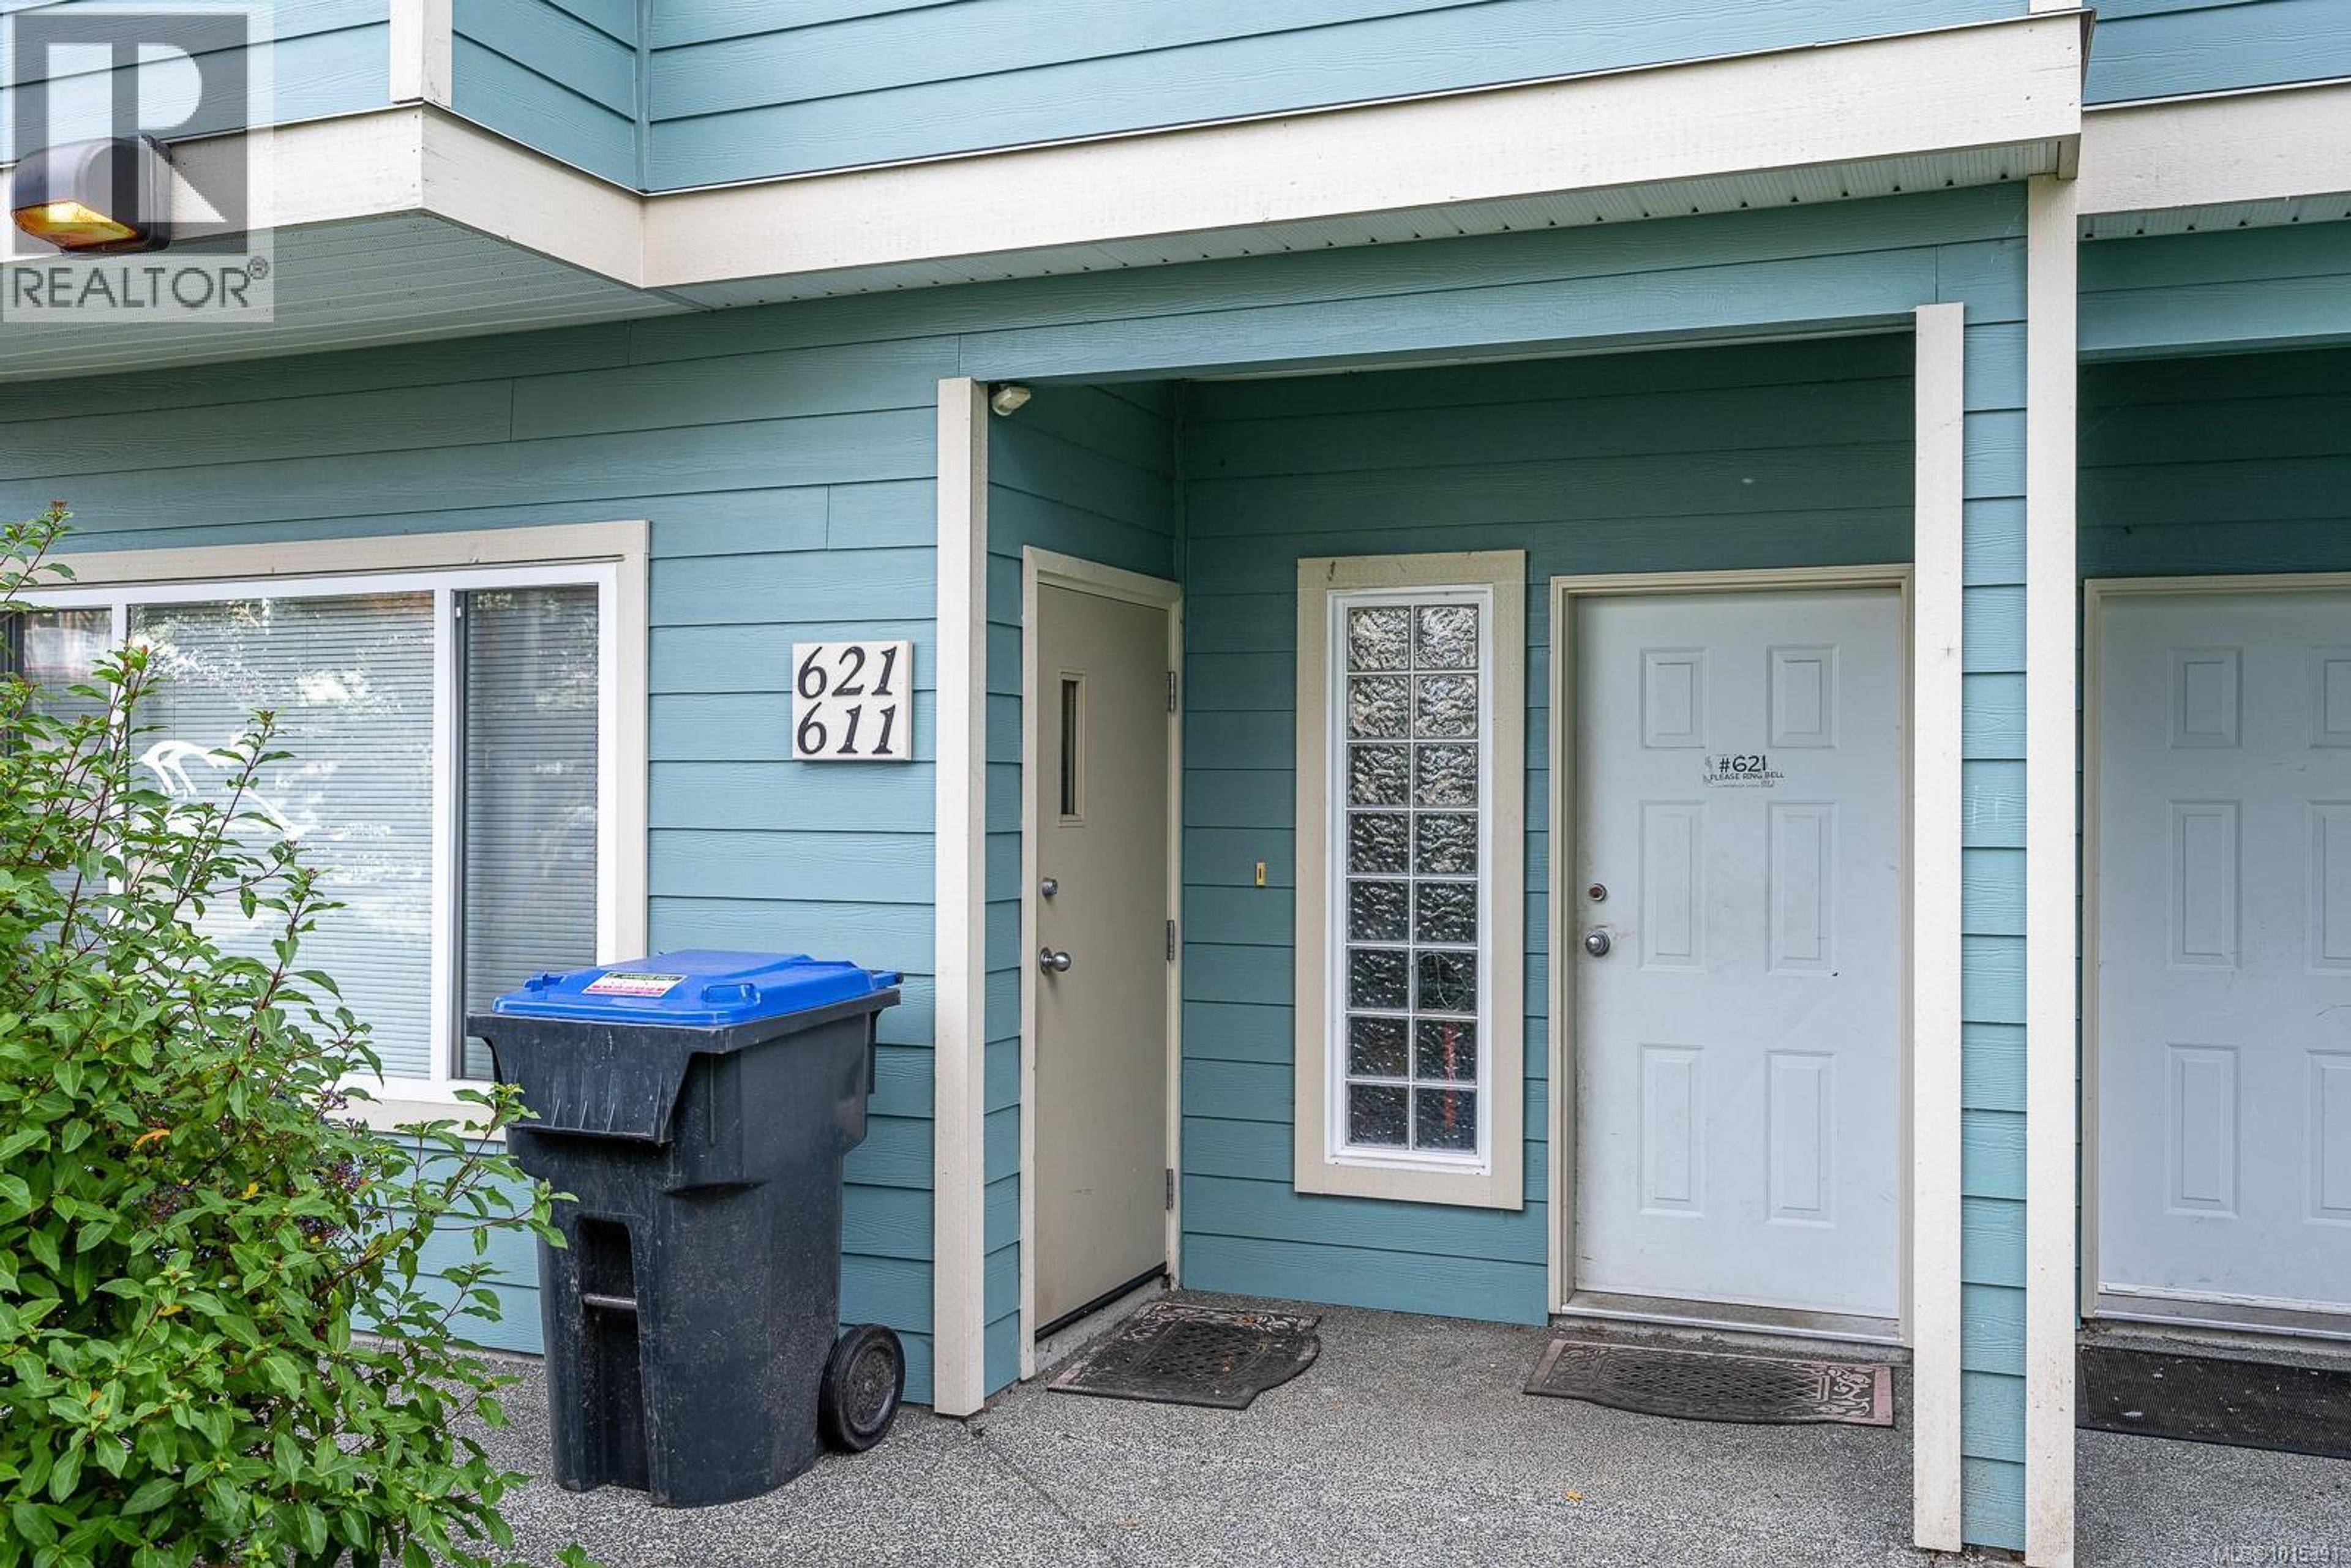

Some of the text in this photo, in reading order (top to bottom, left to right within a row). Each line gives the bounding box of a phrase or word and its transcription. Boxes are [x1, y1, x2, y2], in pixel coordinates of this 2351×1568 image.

[798, 646, 897, 699] 621
[797, 702, 896, 755] 611
[1719, 754, 1766, 773] #621
